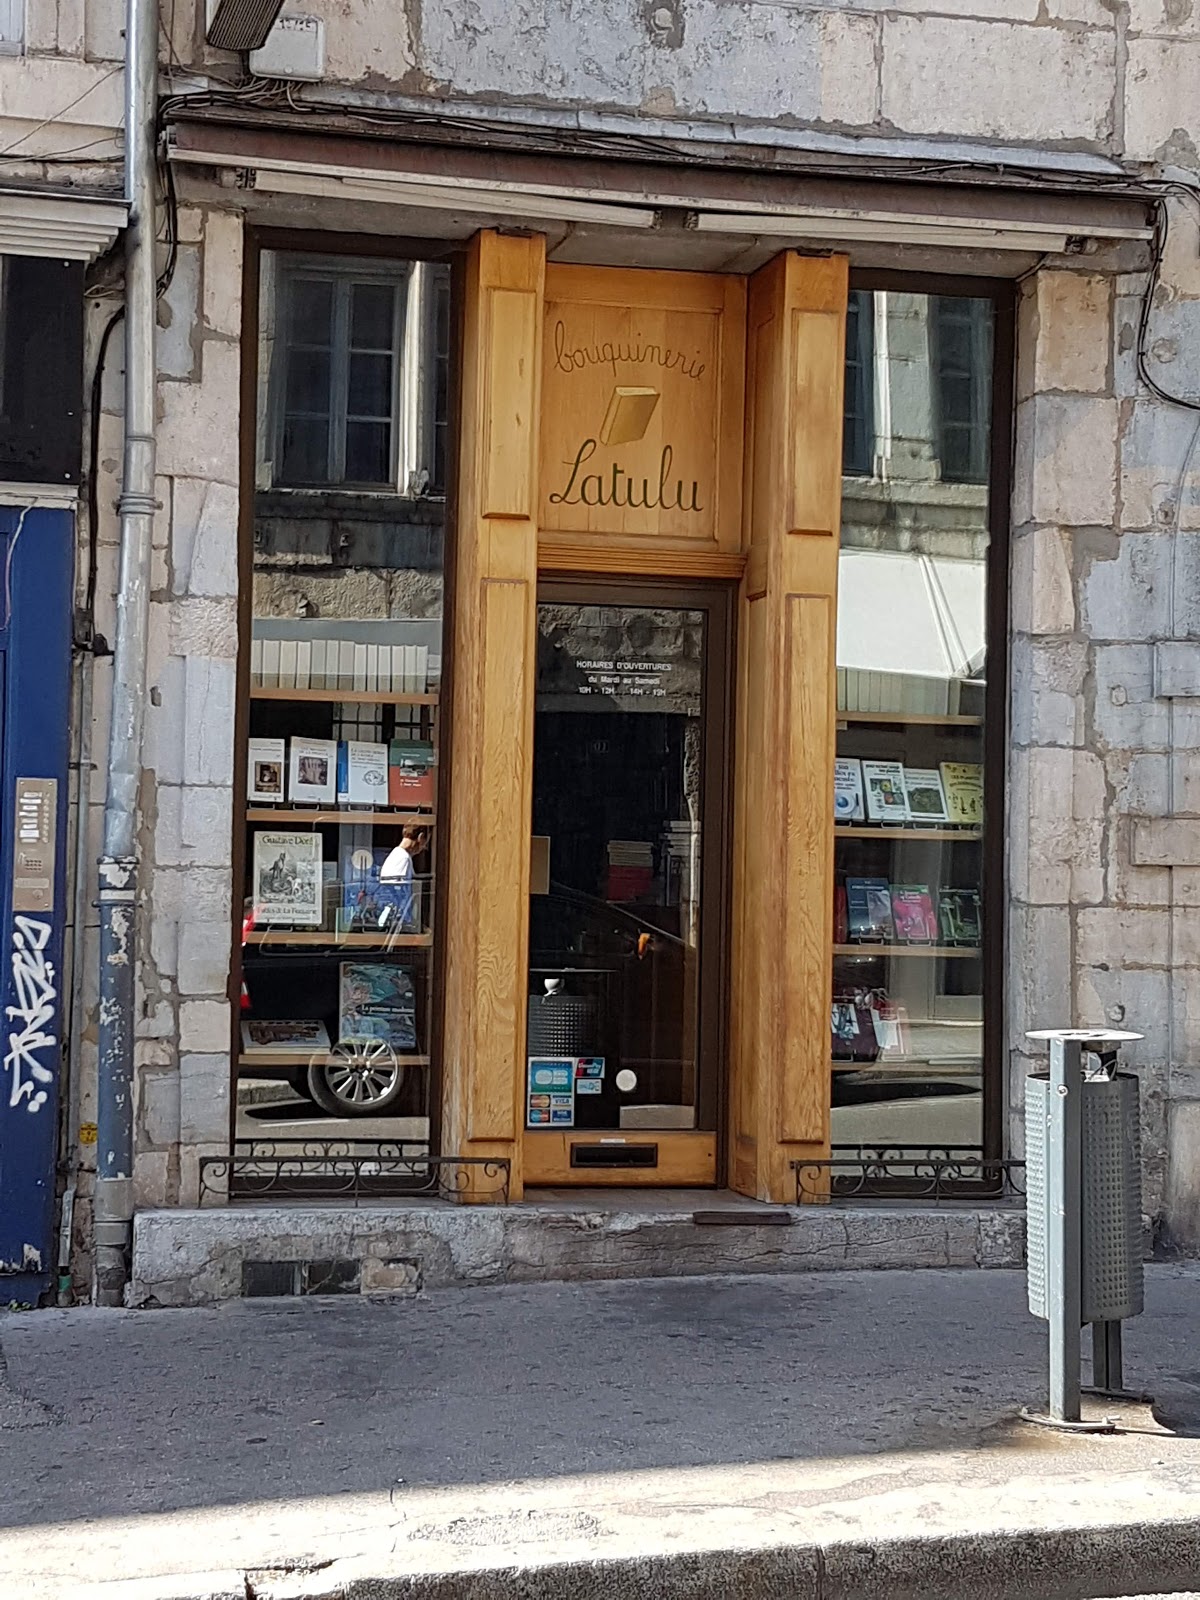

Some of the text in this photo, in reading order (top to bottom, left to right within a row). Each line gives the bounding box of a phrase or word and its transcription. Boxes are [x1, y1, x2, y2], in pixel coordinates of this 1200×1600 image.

[553, 320, 706, 381] bouquinerie
[549, 438, 703, 512] Latulu
[576, 660, 672, 671] HORAIRES D'OUVERTURES
[635, 677, 660, 685] Samedi
